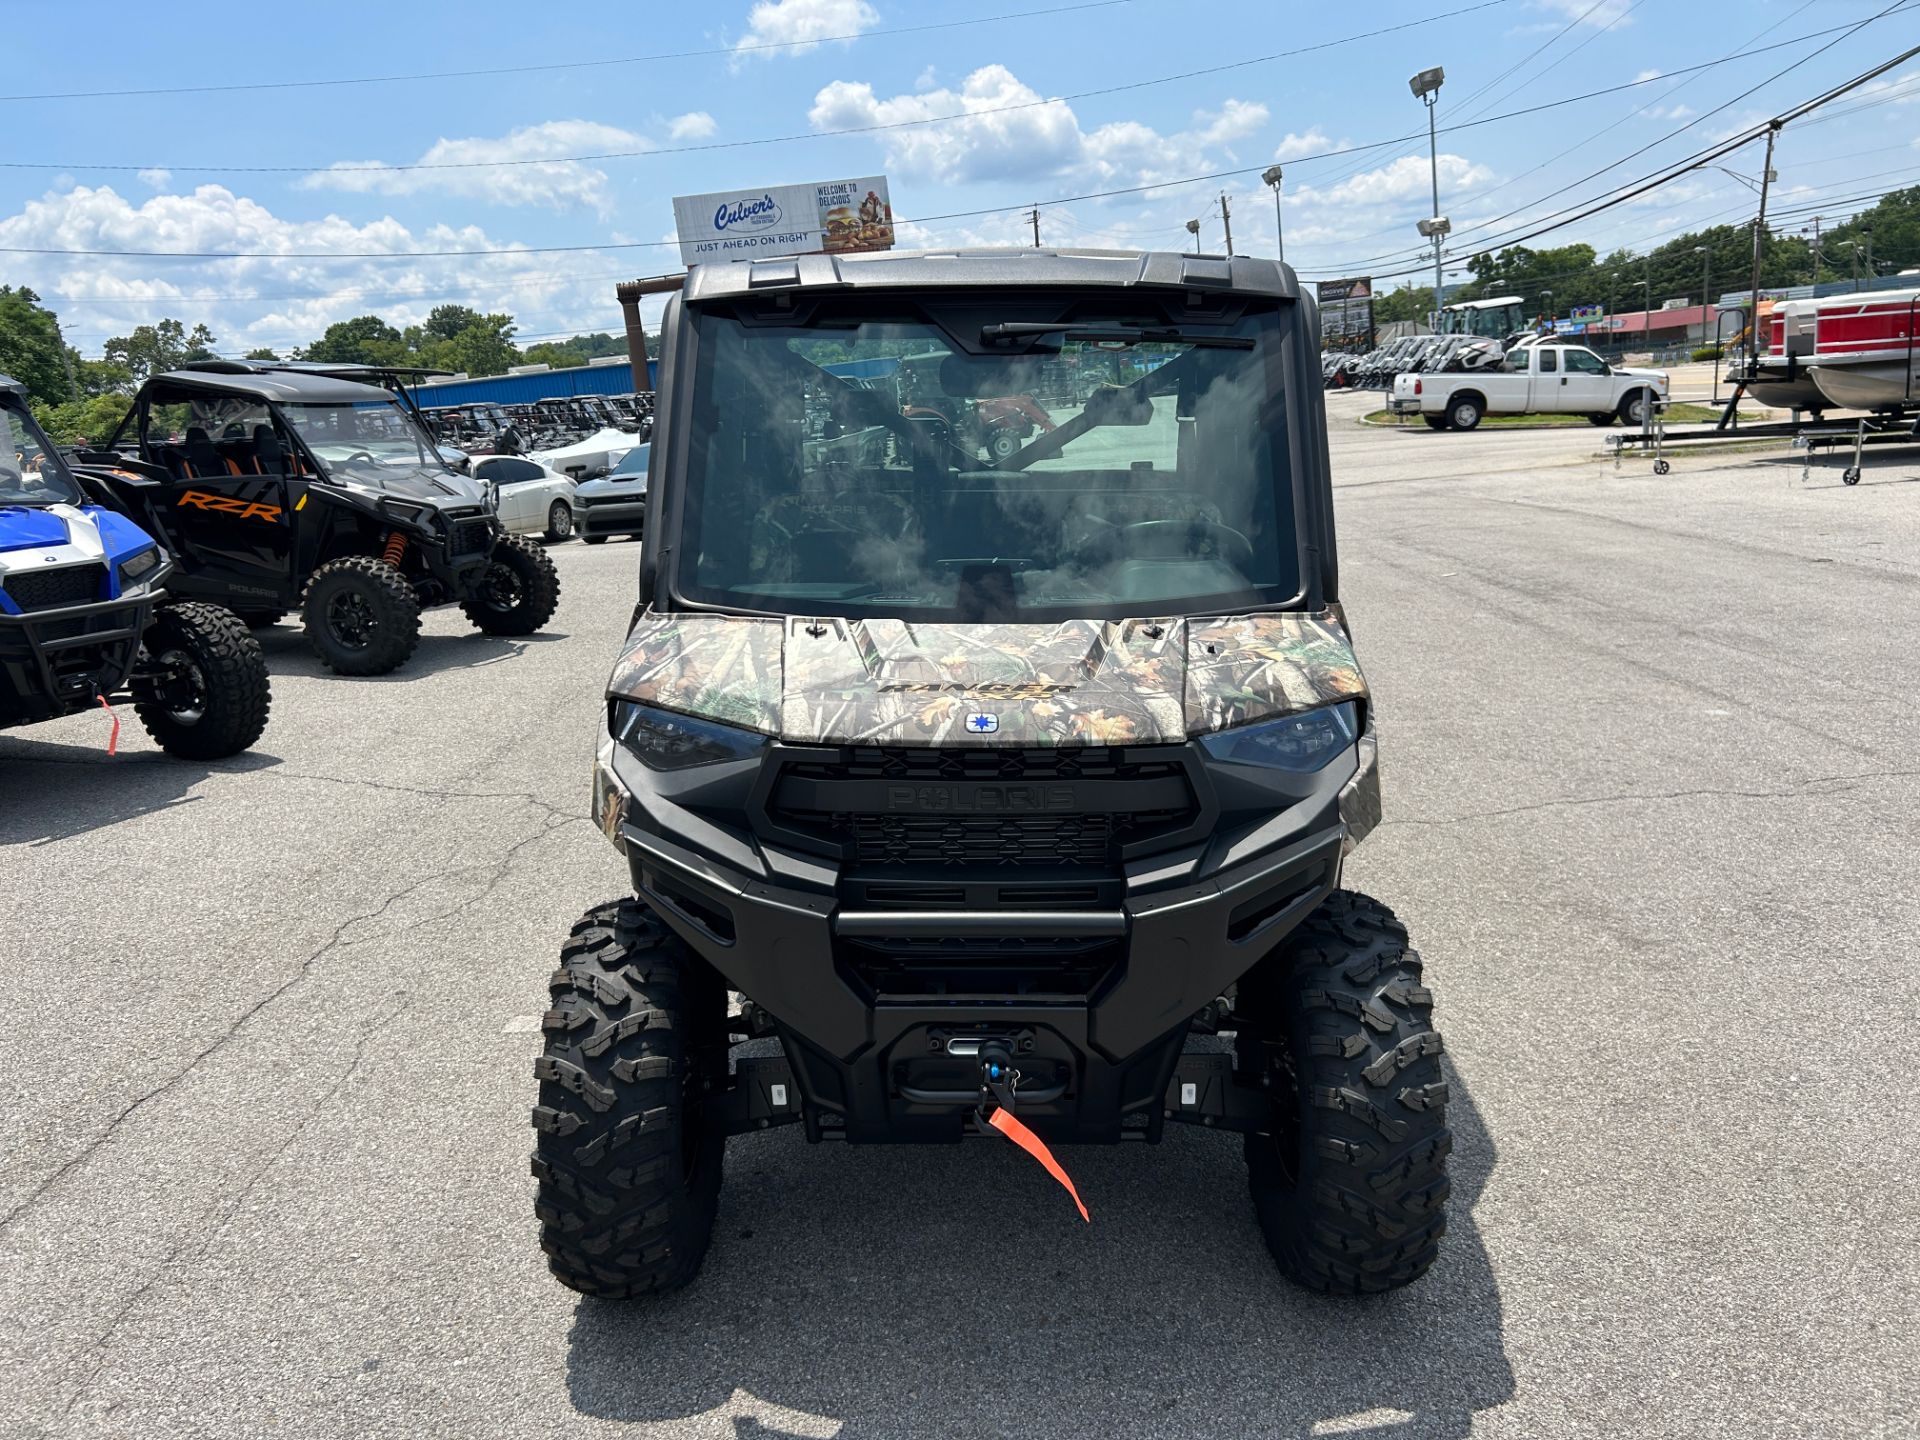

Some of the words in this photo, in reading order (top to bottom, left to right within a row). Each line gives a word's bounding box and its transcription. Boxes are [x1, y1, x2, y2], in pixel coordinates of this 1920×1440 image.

[817, 184, 848, 196] WELCOME
[848, 183, 857, 193] TO
[818, 194, 851, 207] DELICIOUS
[714, 194, 776, 230] Culver's
[695, 242, 719, 252] JUST
[722, 238, 757, 250] AHEAD
[760, 237, 776, 246] ON
[778, 232, 809, 244] RIGHT
[177, 490, 282, 523] RZR
[228, 583, 279, 599] POLARIS
[877, 683, 1077, 693] RANGER
[888, 786, 1075, 810] POLARIS
